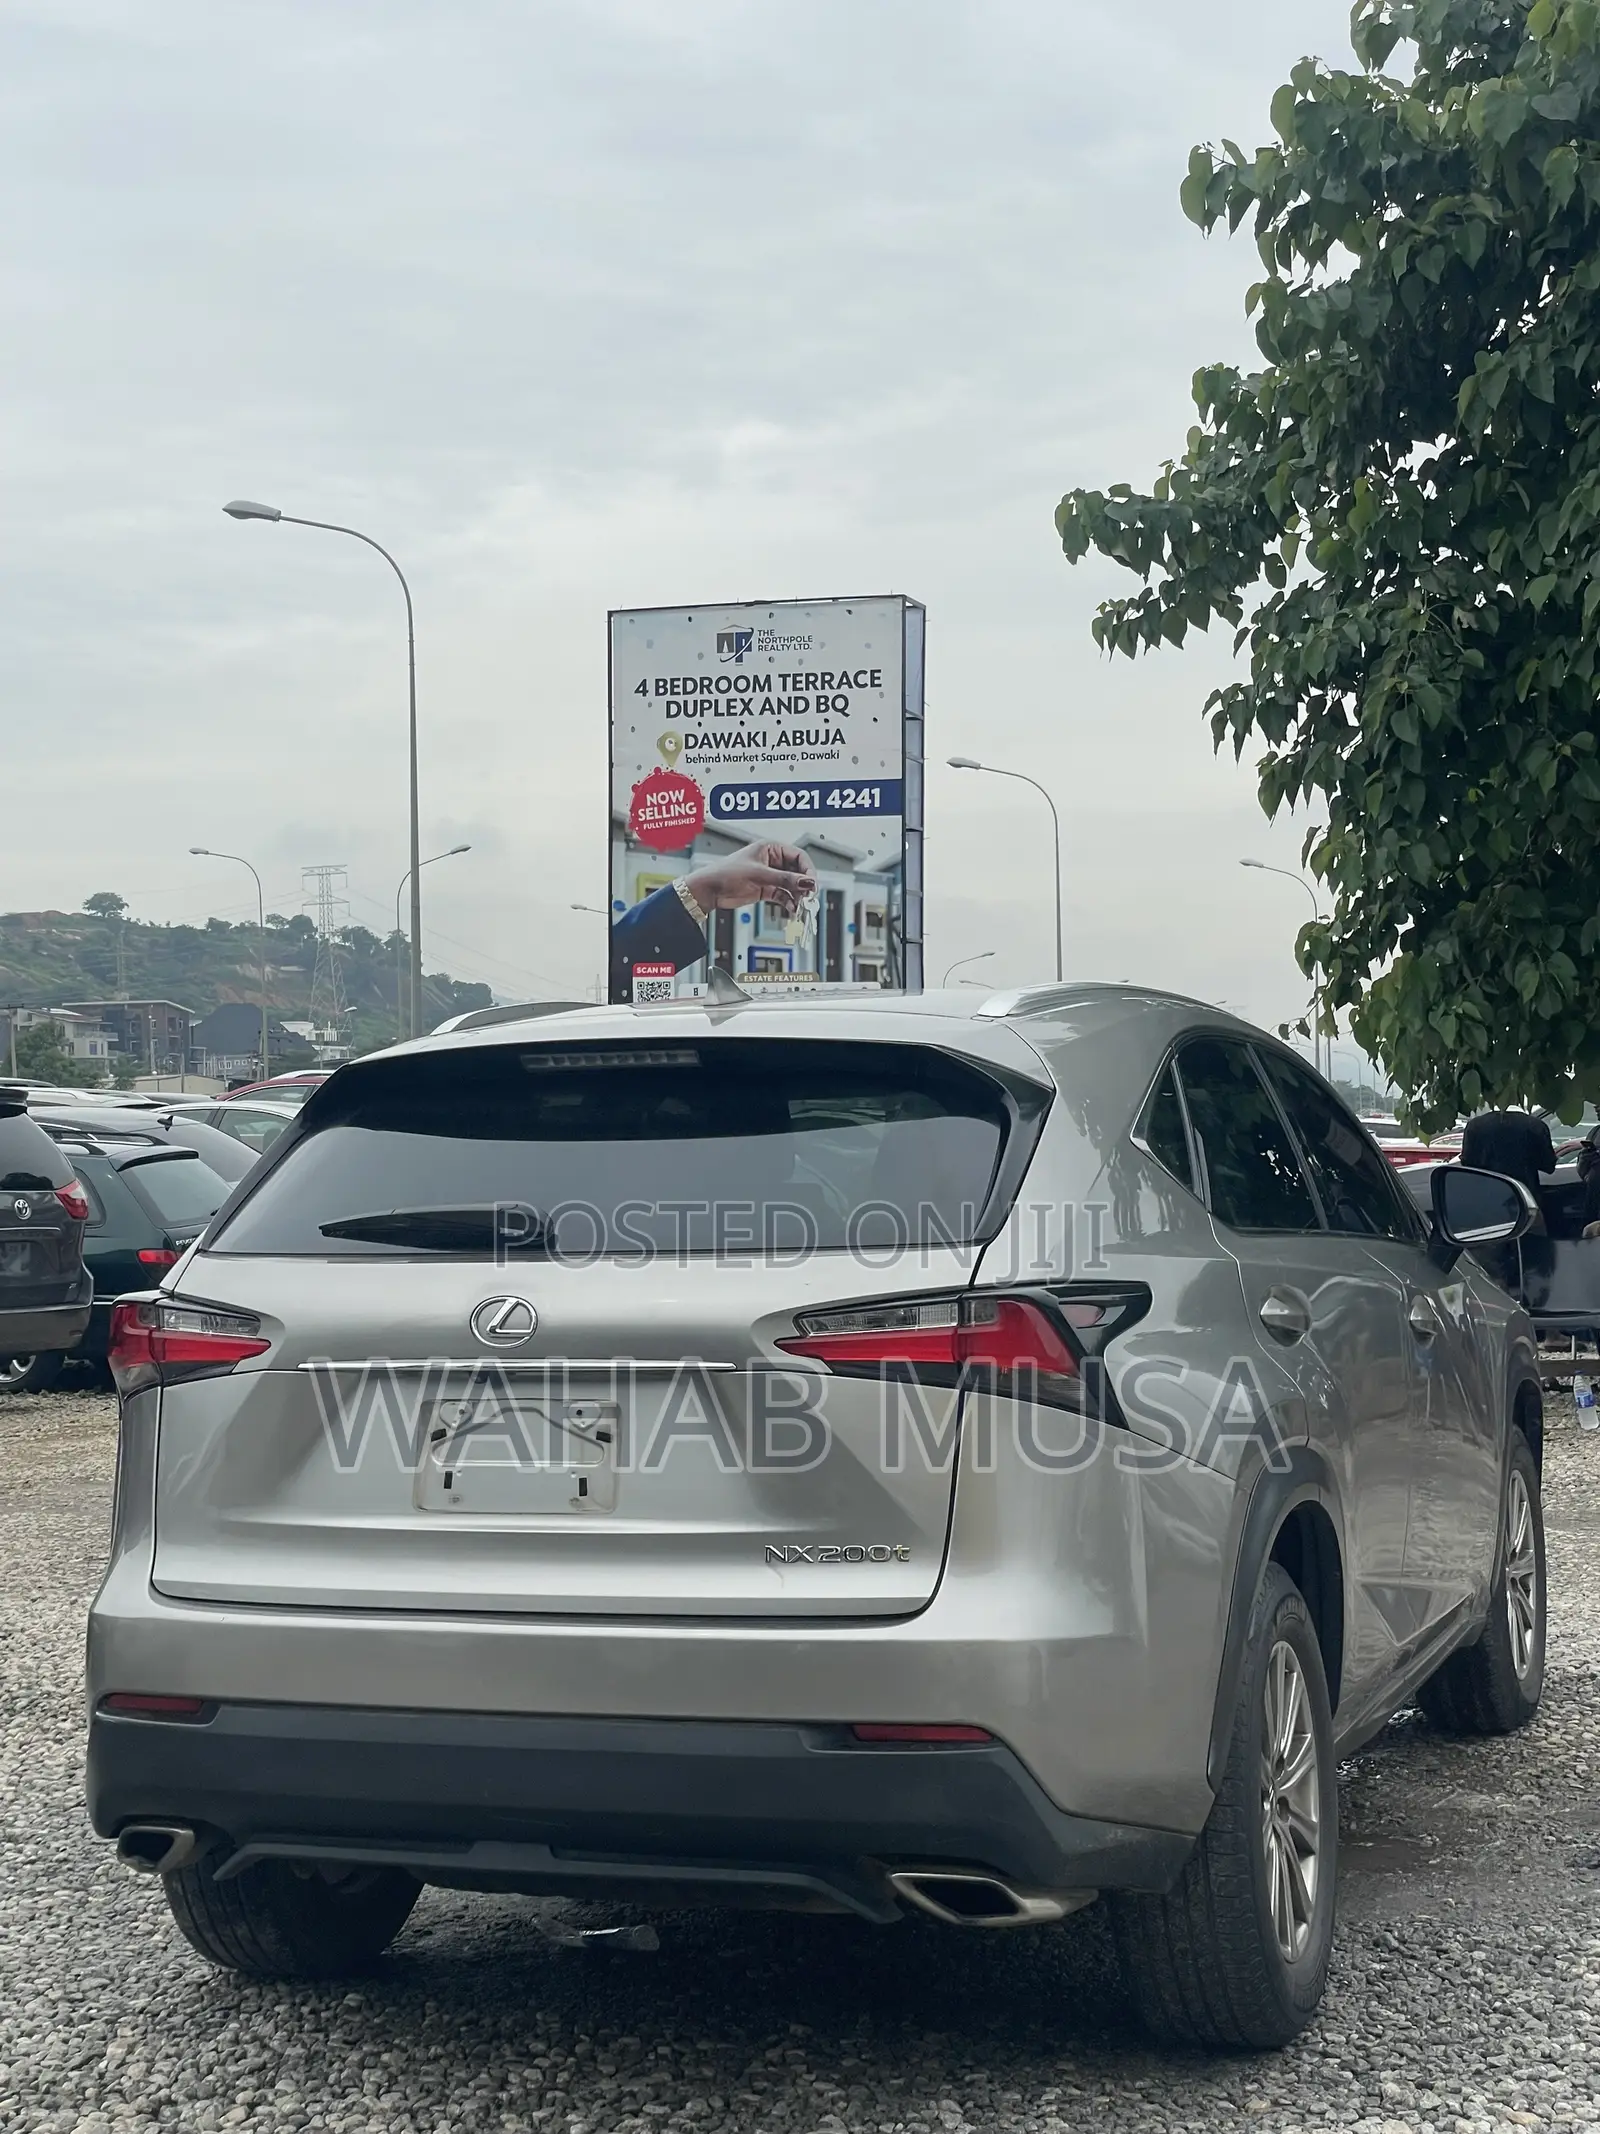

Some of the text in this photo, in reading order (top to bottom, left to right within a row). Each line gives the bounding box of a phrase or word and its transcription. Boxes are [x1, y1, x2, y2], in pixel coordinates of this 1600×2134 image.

[757, 635, 813, 644] NORTHPOLE
[757, 644, 791, 652] REALTY
[635, 669, 882, 697] 4 BEDROOM TERRACE
[665, 694, 850, 719] DUPLEX AND BQ
[684, 731, 767, 750] DAWAKI
[685, 749, 840, 764] behind Market Square, Dawaki
[646, 789, 685, 806] NOW
[719, 787, 881, 811] 091 2021 4241
[638, 802, 697, 822] SELLING
[643, 817, 696, 830] FULLY FINISHED
[636, 966, 672, 974] SCAN ME
[774, 974, 813, 982] FEATURES
[765, 1544, 910, 1563] NX200t
